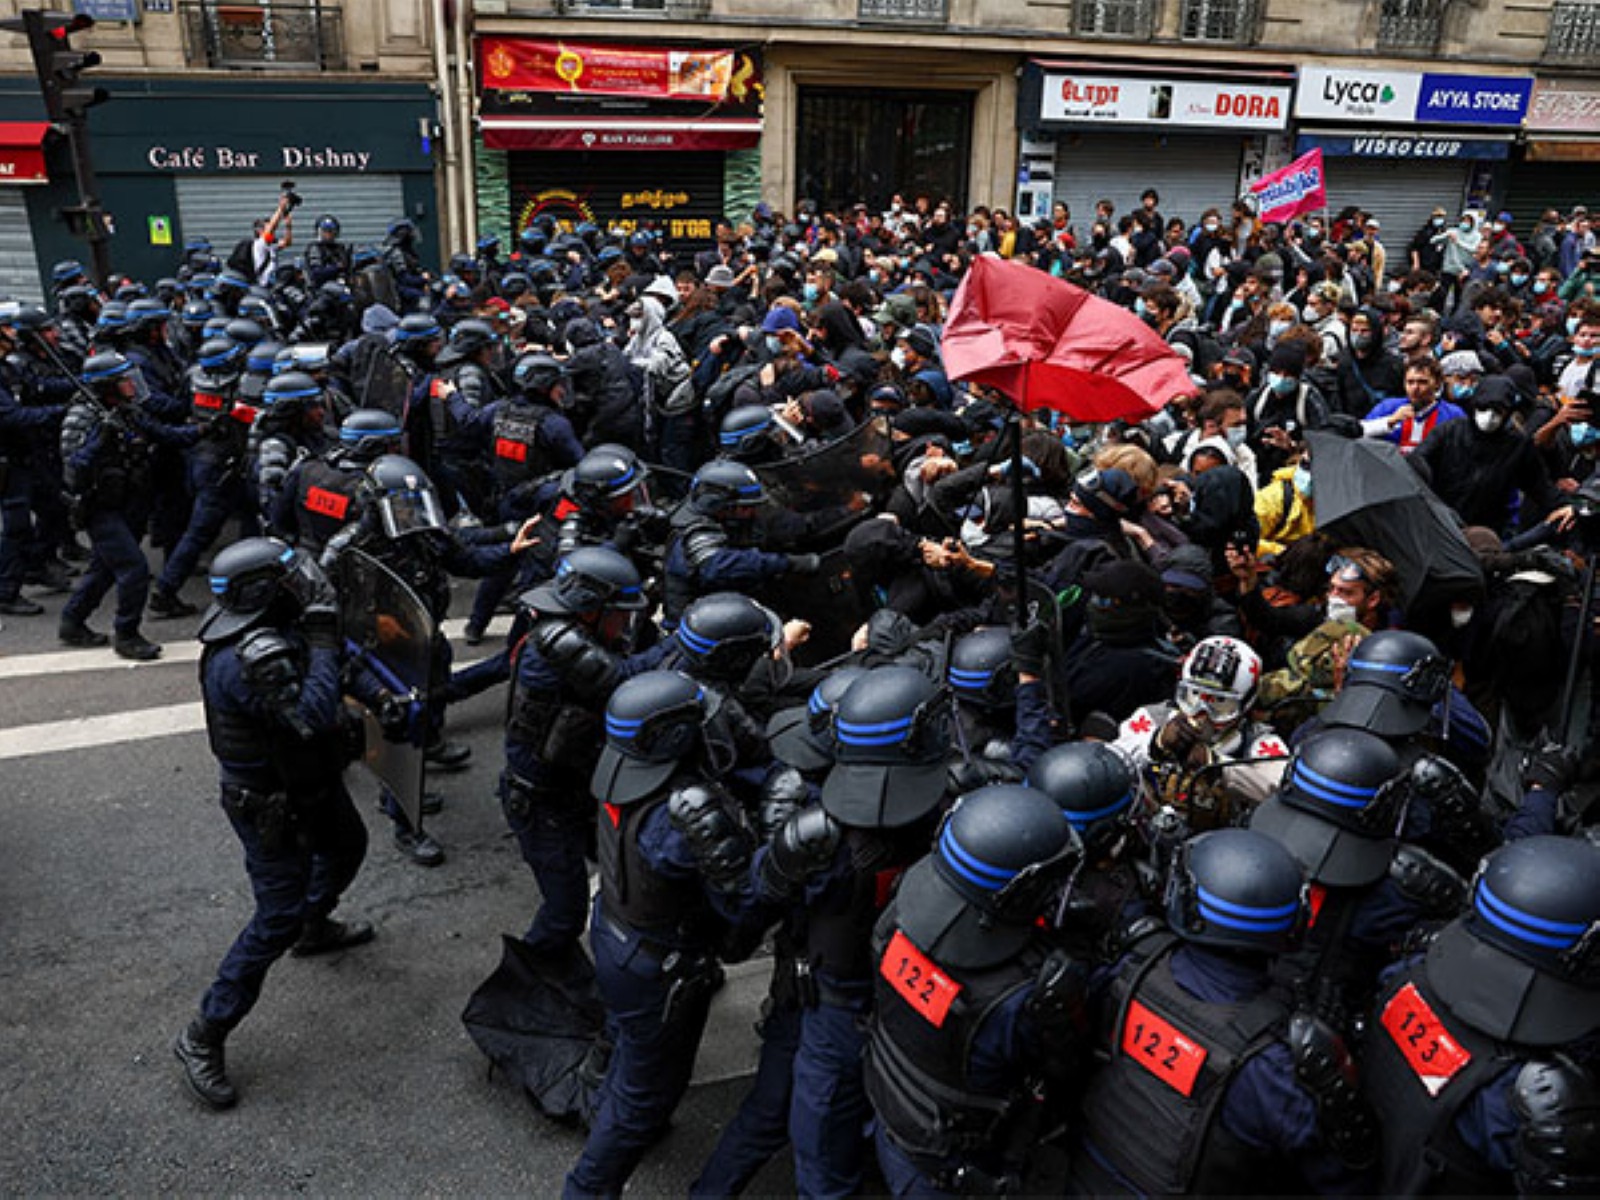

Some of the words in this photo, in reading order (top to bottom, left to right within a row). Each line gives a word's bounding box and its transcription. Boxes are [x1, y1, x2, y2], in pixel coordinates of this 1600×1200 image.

[1323, 75, 1379, 105] Lyca
[1427, 89, 1469, 108] AYYA
[1472, 91, 1521, 111] STORE
[1215, 94, 1280, 118] DORA
[148, 146, 205, 168] Café
[217, 147, 259, 167] Bar
[282, 147, 370, 170] Dishny
[1352, 138, 1413, 156] VIDEO
[1414, 141, 1462, 157] CLUB
[897, 958, 936, 1004] 122
[1133, 1024, 1181, 1071] 122
[1400, 1011, 1439, 1062] 123
